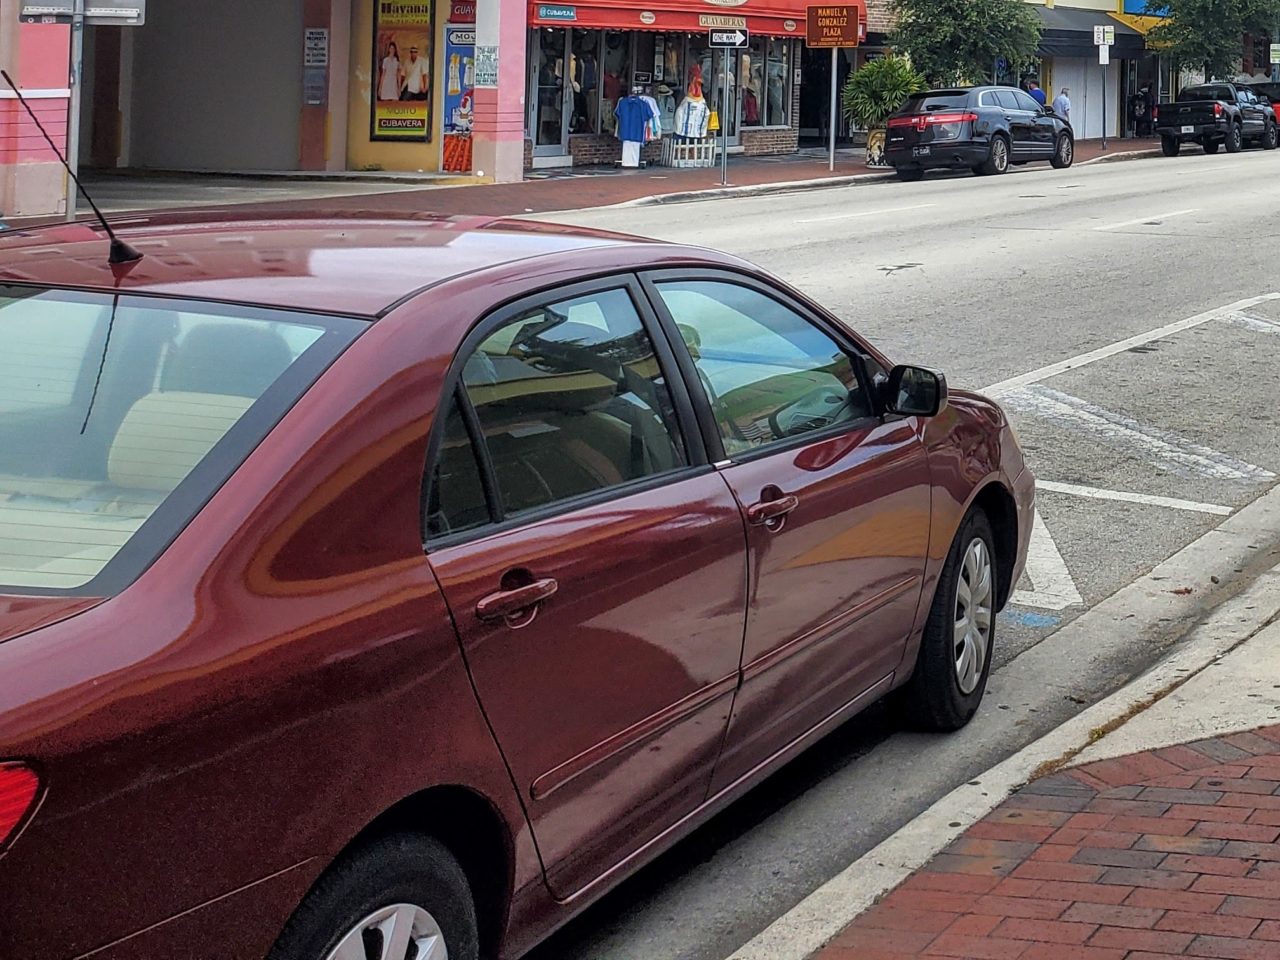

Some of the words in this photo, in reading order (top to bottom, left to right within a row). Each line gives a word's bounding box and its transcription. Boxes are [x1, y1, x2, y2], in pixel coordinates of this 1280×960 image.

[817, 8, 841, 16] MANUEL
[842, 8, 847, 16] A
[700, 16, 745, 26] GUAYABERAS
[817, 18, 847, 26] GONZALEZ
[823, 27, 842, 36] PLAZA
[713, 34, 724, 42] ONE
[725, 34, 737, 42] WAY
[381, 119, 422, 127] CUBAVERA
